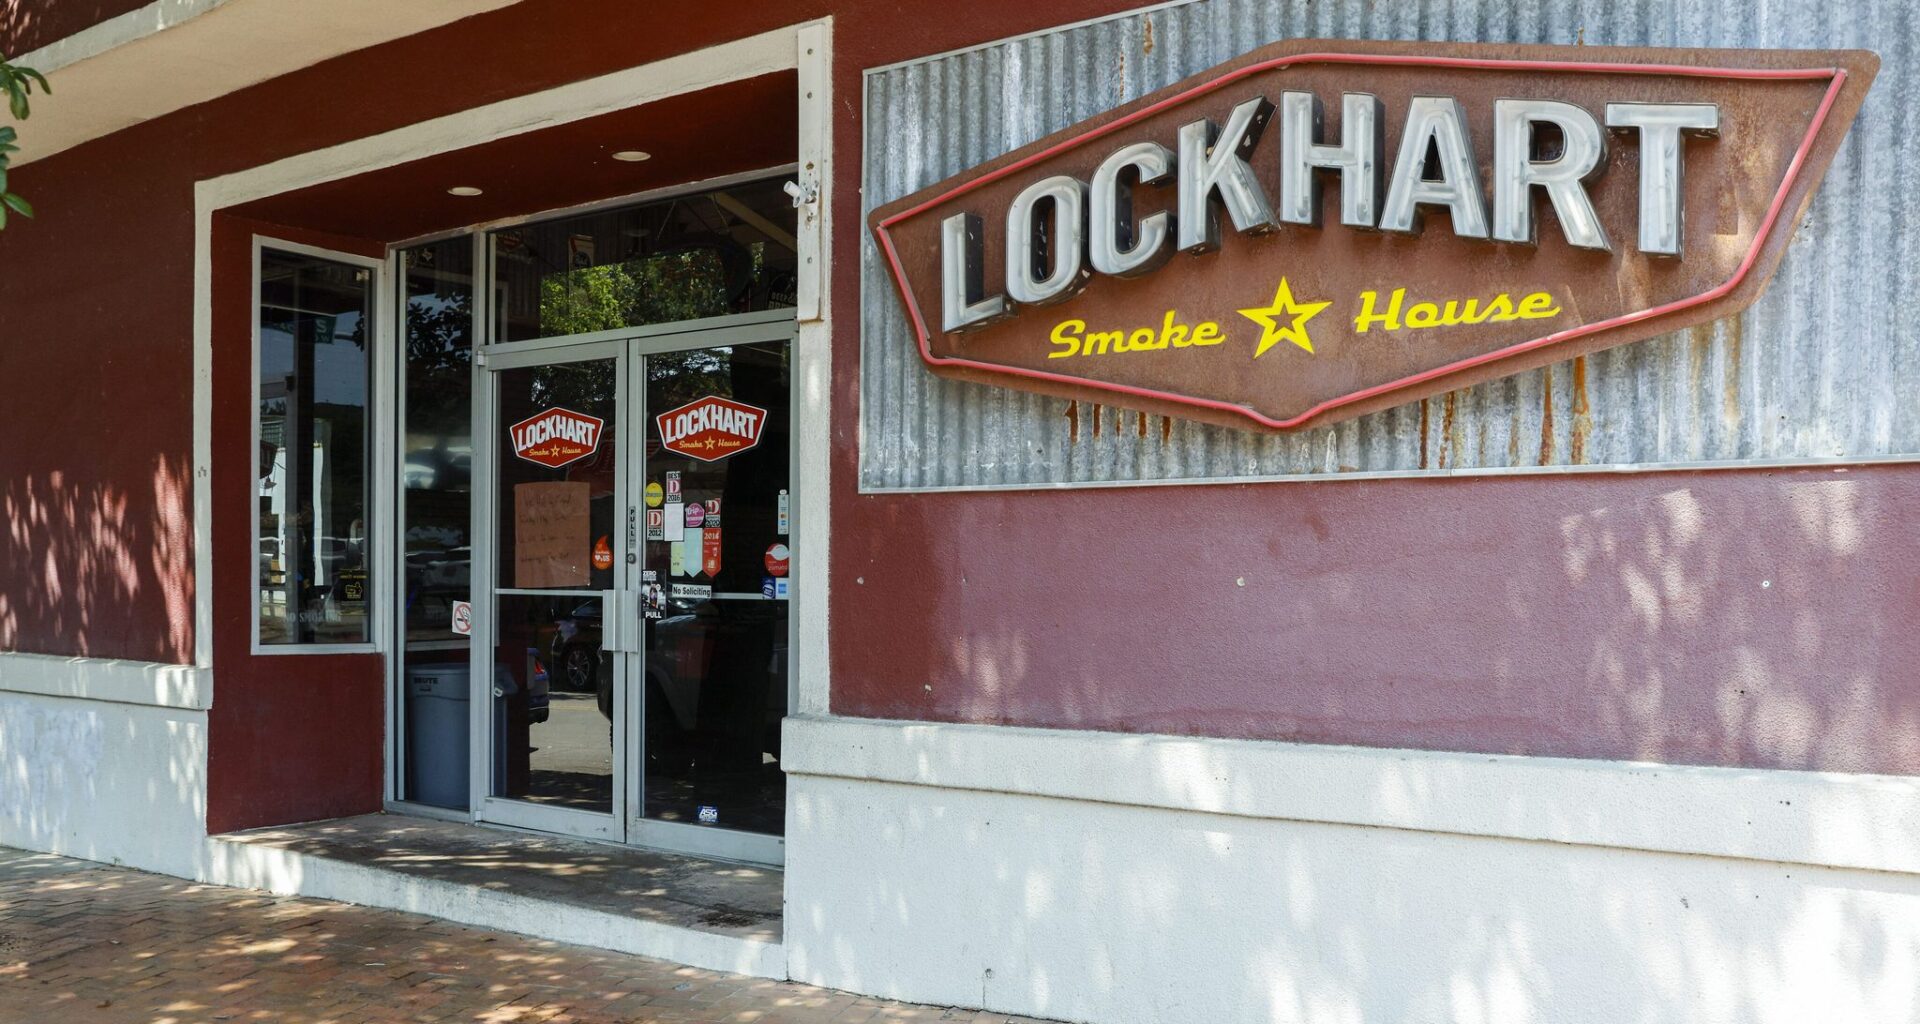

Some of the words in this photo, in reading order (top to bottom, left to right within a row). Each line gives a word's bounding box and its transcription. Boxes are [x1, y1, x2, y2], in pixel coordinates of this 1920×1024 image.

[941, 90, 1720, 334] LOCKHART
[1047, 310, 1226, 358] Smoke
[1354, 287, 1561, 333] House
[663, 403, 757, 444] LOCKHART
[517, 414, 595, 452] LOCKHART
[679, 440, 703, 449] Smoke
[718, 438, 741, 447] House
[529, 448, 549, 457] Smoke
[562, 446, 581, 454] House
[669, 480, 680, 494] D
[667, 494, 681, 502] 2016
[650, 512, 661, 526] D
[648, 529, 662, 537] 2012
[683, 586, 711, 598] Soliciting
[645, 611, 662, 619] PULL
[700, 808, 717, 816] ASG
